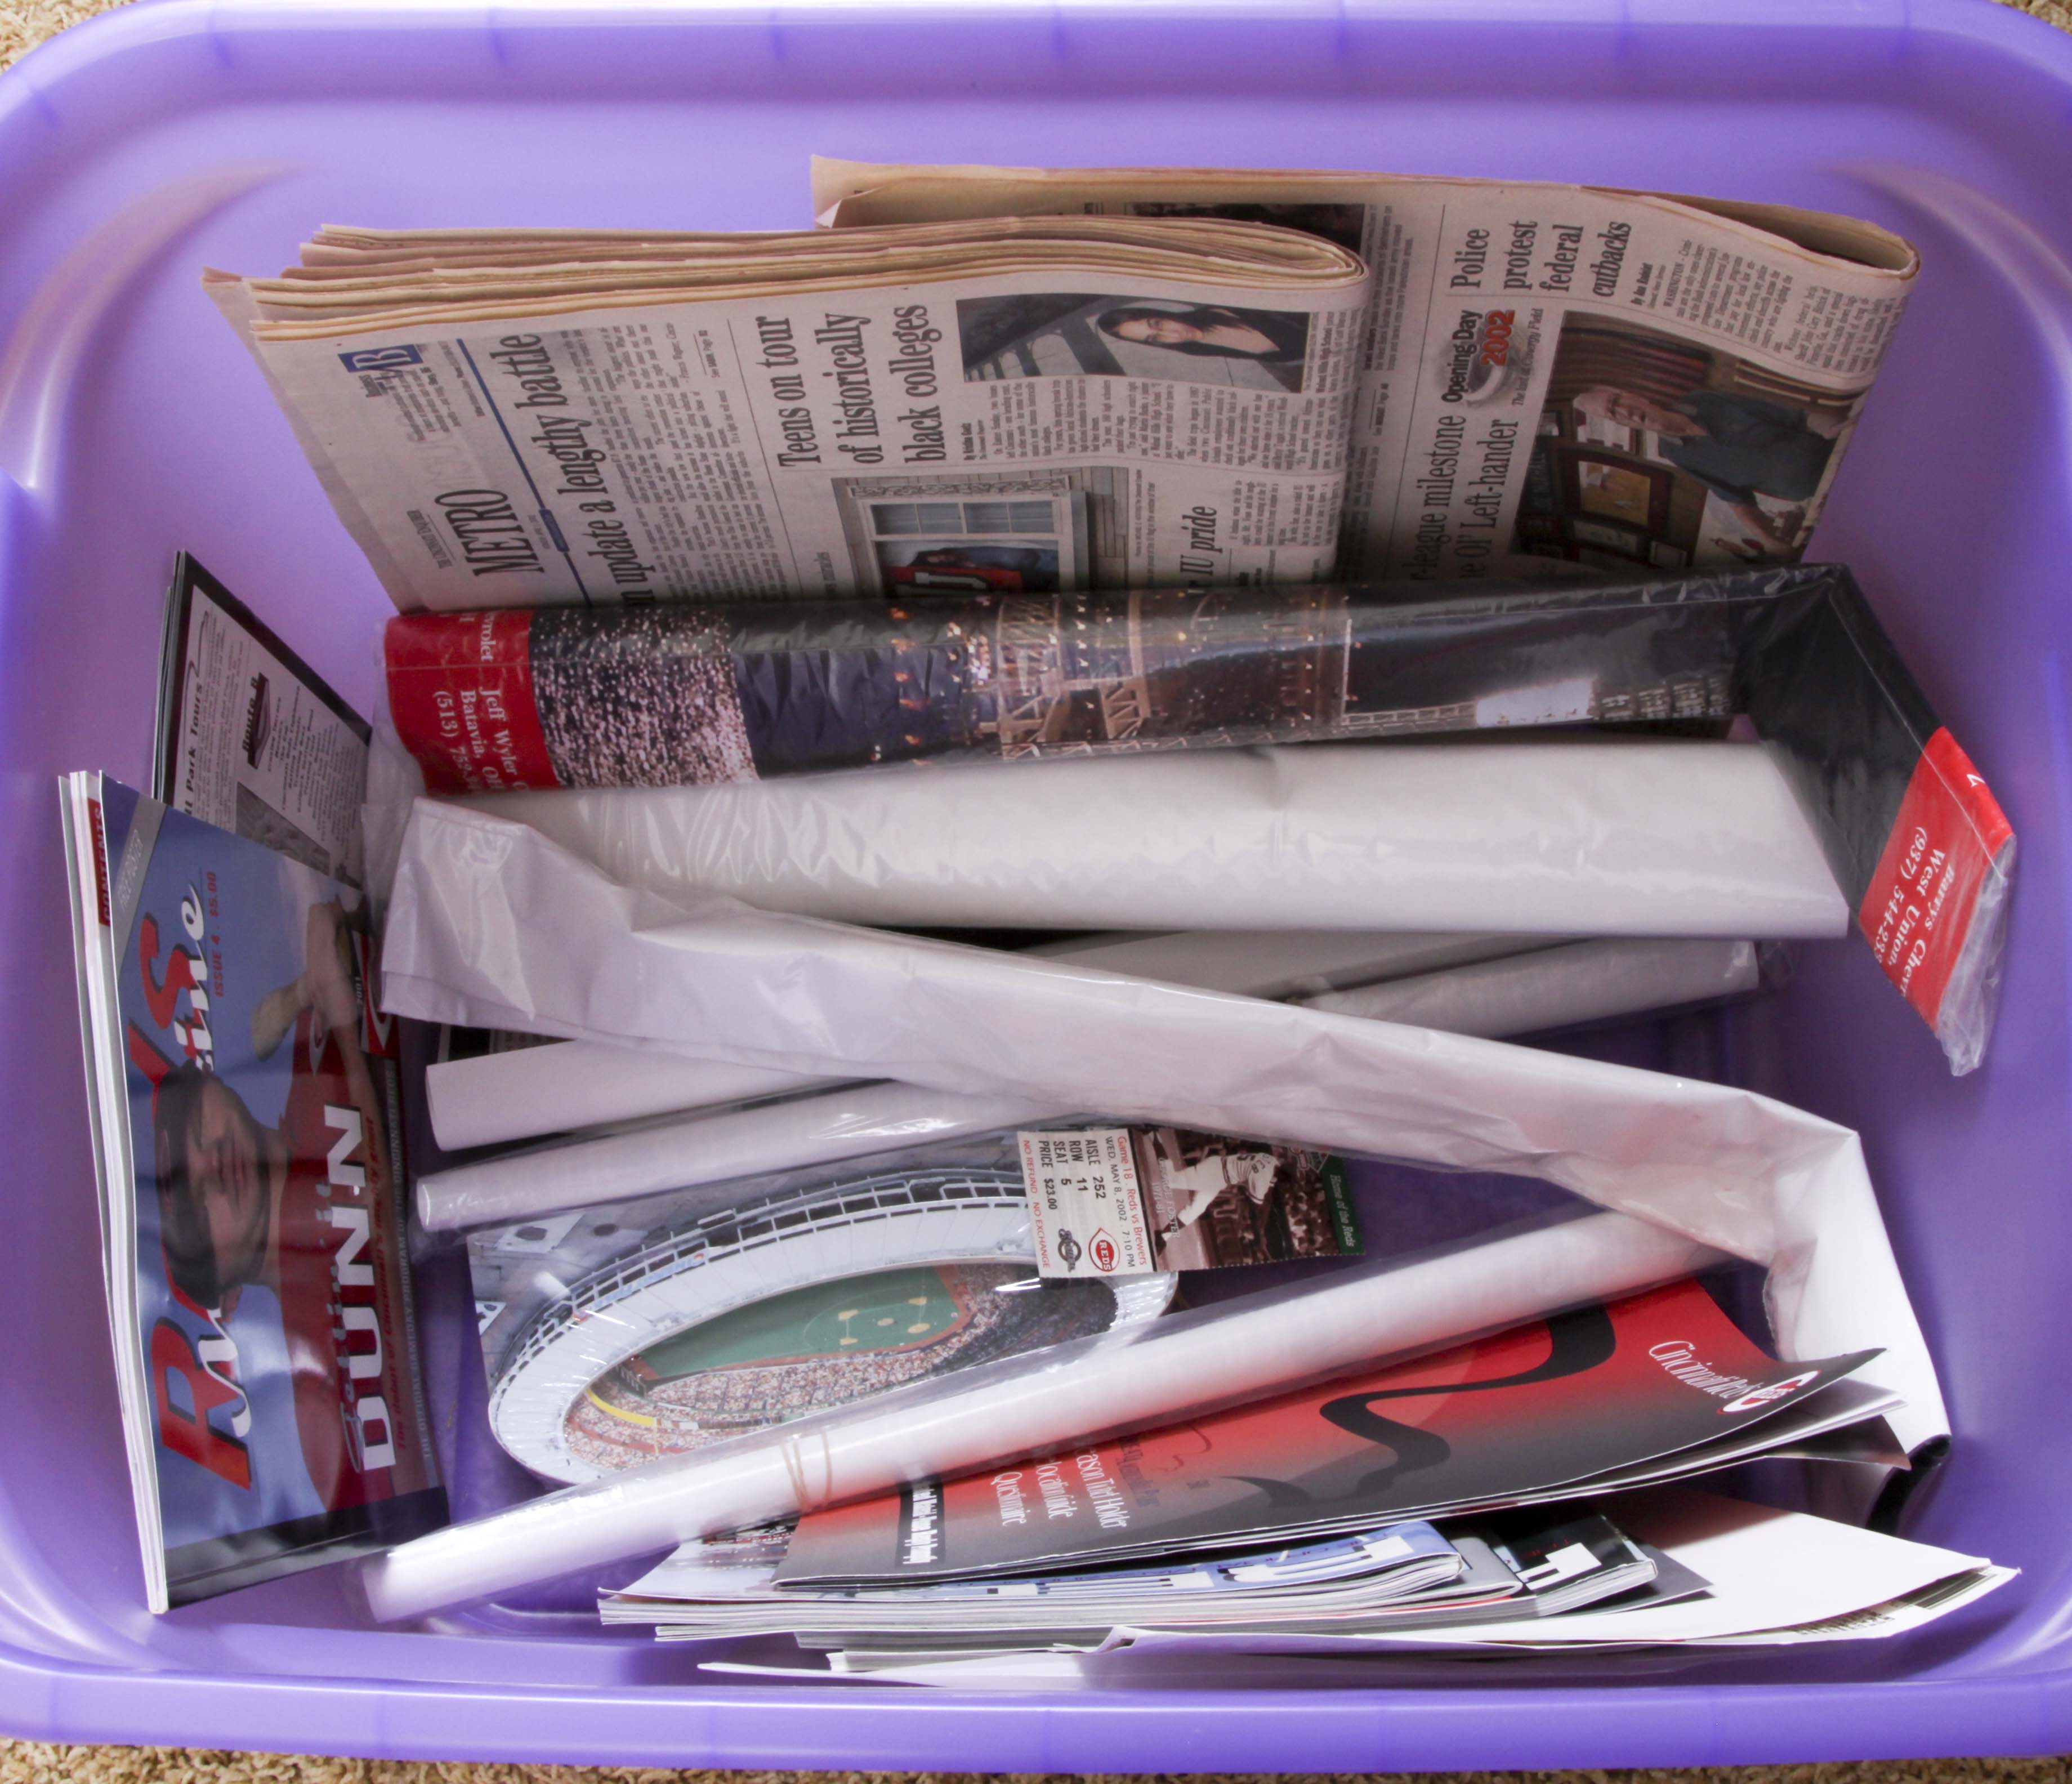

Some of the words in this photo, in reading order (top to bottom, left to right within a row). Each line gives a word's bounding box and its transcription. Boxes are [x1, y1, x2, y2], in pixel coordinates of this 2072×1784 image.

[1450, 229, 1490, 288] Police
[1503, 220, 1538, 290] protest
[1539, 224, 1584, 292] federal
[1590, 221, 1631, 297] cutbacks
[1663, 262, 1684, 306] WASHINGTON
[754, 315, 799, 368] tour
[1452, 310, 1482, 340] Day
[1479, 309, 1515, 366] 2002
[352, 348, 412, 369] B
[489, 333, 569, 409] battle
[888, 304, 943, 398] colleges
[1441, 344, 1477, 403] Opening
[1512, 393, 1525, 405] The
[1527, 309, 1543, 330] Field
[770, 374, 806, 401] on
[814, 313, 881, 438] historically
[531, 414, 608, 494] lengthy
[777, 408, 822, 467] Teens
[837, 444, 885, 464] of
[896, 405, 948, 463] black
[1416, 416, 1466, 507] milestone
[1459, 419, 1519, 529] Left-hander
[578, 499, 617, 513] a
[434, 489, 544, 577] METRO
[580, 519, 655, 584] update
[1181, 506, 1222, 553] pride
[1180, 555, 1214, 576] IU
[190, 681, 203, 736] Tours
[432, 690, 459, 738] (513)
[459, 689, 488, 759] Batavia,
[479, 686, 507, 721] Jeff
[493, 729, 517, 775] Wyler
[186, 746, 197, 792] Park
[1900, 826, 1927, 880] (937)
[1915, 849, 1946, 897] West
[207, 871, 219, 917] $5.00
[1923, 864, 1955, 931] Barrys
[210, 935, 221, 945] 4
[1887, 905, 1921, 966] Union,
[212, 951, 225, 997] ISSUE
[355, 977, 363, 1005] 2001
[366, 1117, 378, 1164] giant
[390, 1107, 402, 1183] CINCINNATI
[1023, 1140, 1031, 1154] NO
[1038, 1140, 1053, 1168] PRICE
[1053, 1141, 1068, 1164] SEAT
[1085, 1139, 1101, 1166] AISLE
[1117, 1136, 1128, 1164] Game
[1026, 1157, 1037, 1194] REFUND
[1069, 1140, 1084, 1162] ROW
[1077, 1177, 1088, 1192] 11
[1092, 1176, 1106, 1199] 252
[1110, 1164, 1120, 1184] MAY
[1123, 1167, 1133, 1179] 18
[1329, 1175, 1342, 1199] Home
[1031, 1202, 1041, 1216] NO
[1043, 1179, 1057, 1210] $23.00
[1115, 1198, 1127, 1221] 2002
[1127, 1189, 1139, 1211] Reds
[1336, 1201, 1347, 1209] of
[1338, 1211, 1350, 1224] the
[1122, 1230, 1132, 1251] 7:10
[1131, 1214, 1140, 1224] vs
[1166, 1201, 1180, 1238] FOSTER
[1342, 1225, 1356, 1246] Reds
[1035, 1219, 1050, 1269] EXCHANGE
[1099, 1241, 1112, 1271] REDS
[1126, 1254, 1135, 1268] PM
[1133, 1226, 1147, 1265] Brewers
[324, 1104, 396, 1470] DUNN
[397, 1237, 412, 1302] PROGRAM
[386, 1340, 395, 1359] of
[405, 1307, 418, 1370] GAMEDAY
[1649, 1340, 1740, 1389] Cincinnati
[388, 1364, 402, 1415] debut
[413, 1377, 426, 1430] OFFICIAL
[396, 1421, 406, 1450] The
[422, 1438, 432, 1458] THE
[991, 1471, 1029, 1526] Questionnaire
[1035, 1462, 1069, 1495] location
[1077, 1454, 1105, 1481] ason
[1093, 1497, 1130, 1528] Holder
